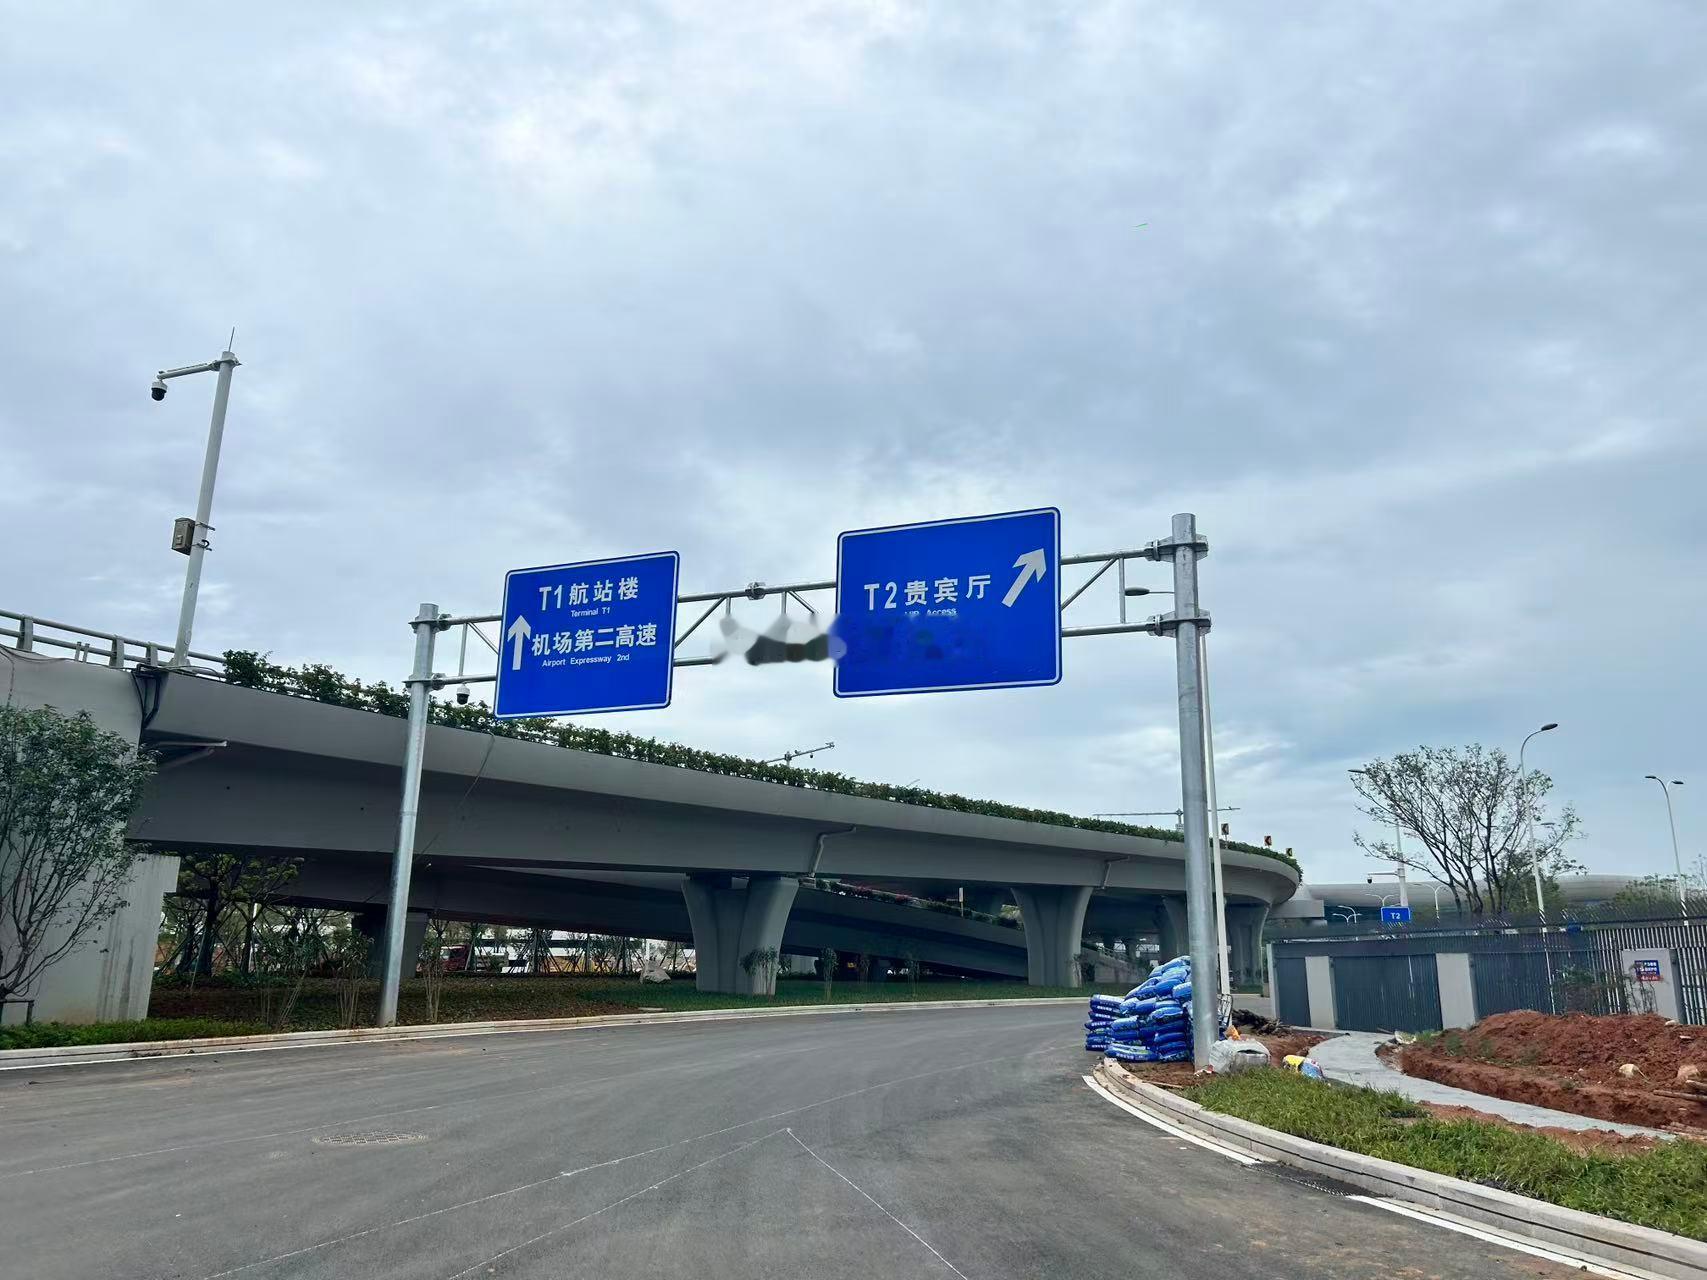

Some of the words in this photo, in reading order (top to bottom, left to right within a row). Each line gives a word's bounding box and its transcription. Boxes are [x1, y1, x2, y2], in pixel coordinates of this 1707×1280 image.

[538, 576, 639, 611] T1航站楼
[863, 574, 991, 611] T2贵宾厅
[570, 607, 599, 618] Terminal
[601, 606, 611, 615] T1
[531, 622, 658, 657] 机场第二高速
[541, 658, 566, 667] Airport
[570, 655, 612, 666] Expressway
[616, 653, 630, 662] 2nd
[1390, 912, 1401, 920] T2
